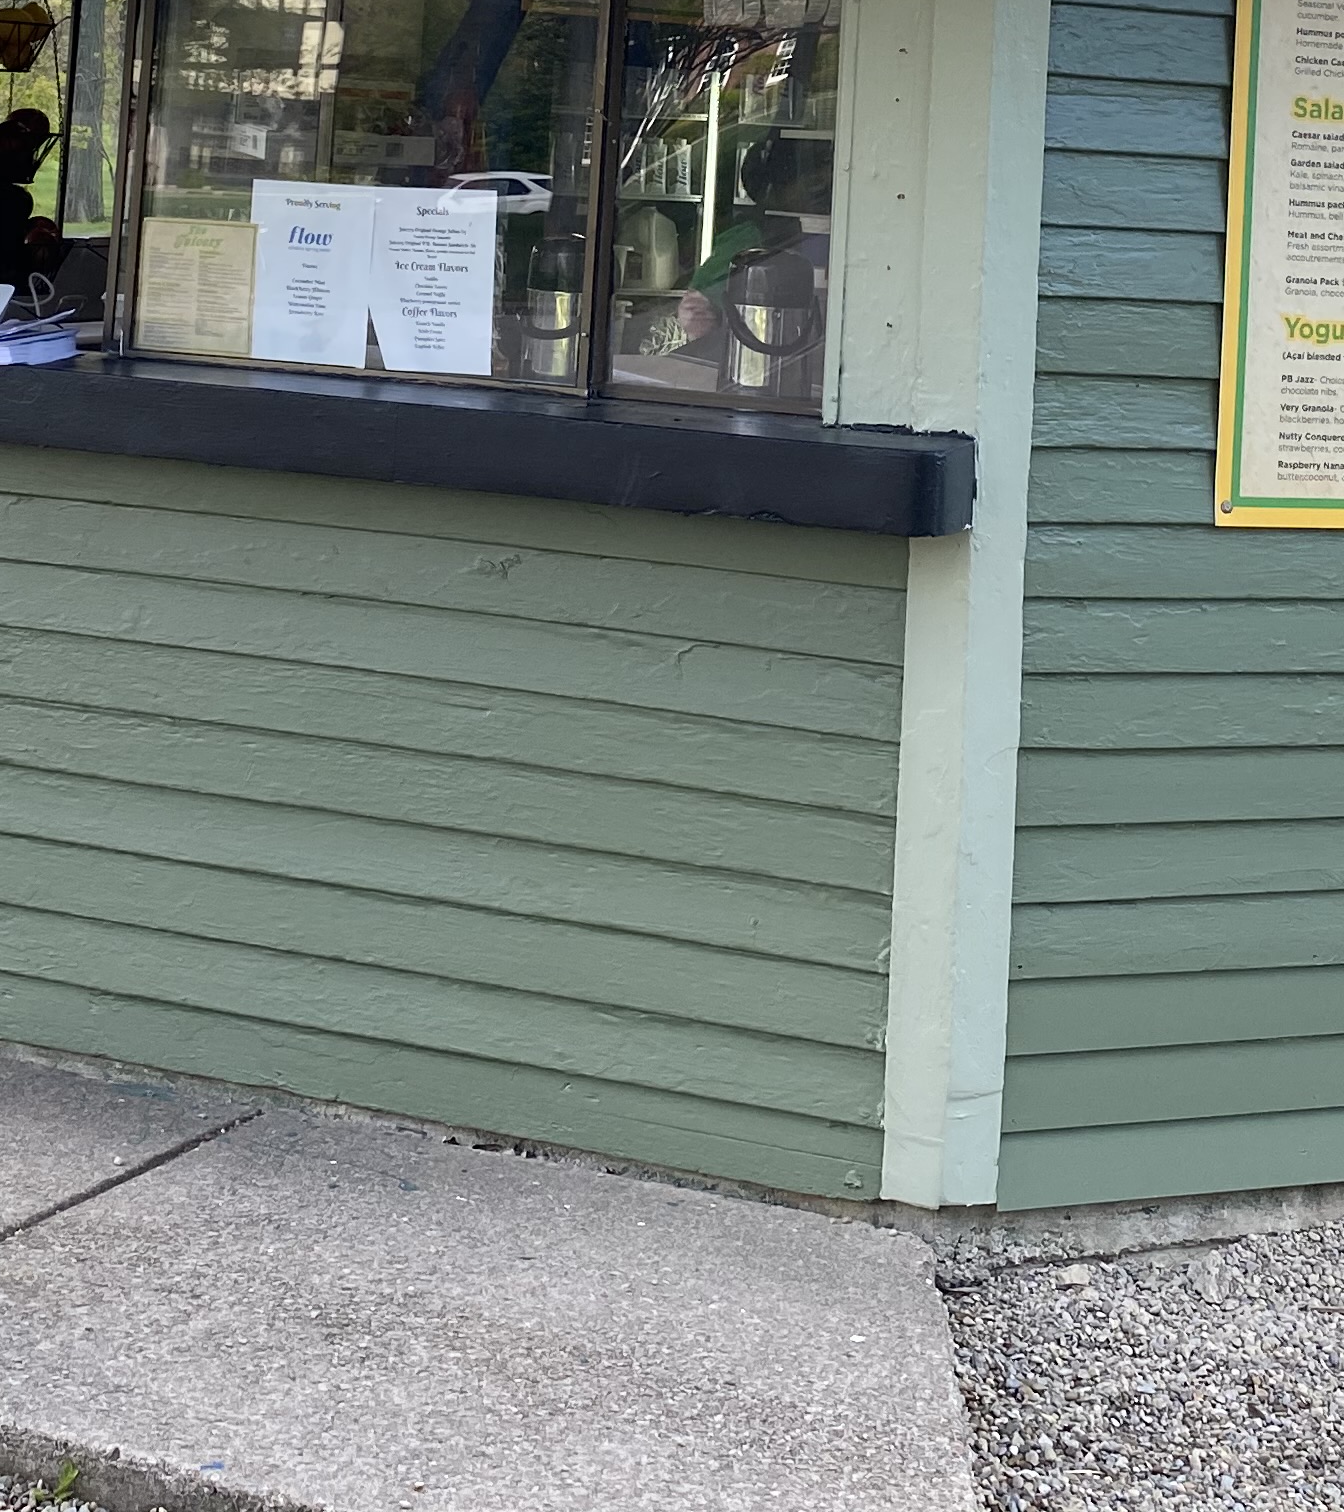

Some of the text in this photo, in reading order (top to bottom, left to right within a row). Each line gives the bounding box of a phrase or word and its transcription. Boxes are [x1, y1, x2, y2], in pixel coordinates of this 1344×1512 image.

[314, 199, 341, 211] Serving
[416, 206, 450, 217] Specials
[288, 225, 334, 246] flow
[395, 260, 469, 272] Ice Cream Flavors
[402, 307, 458, 318] Coffee Flavors
